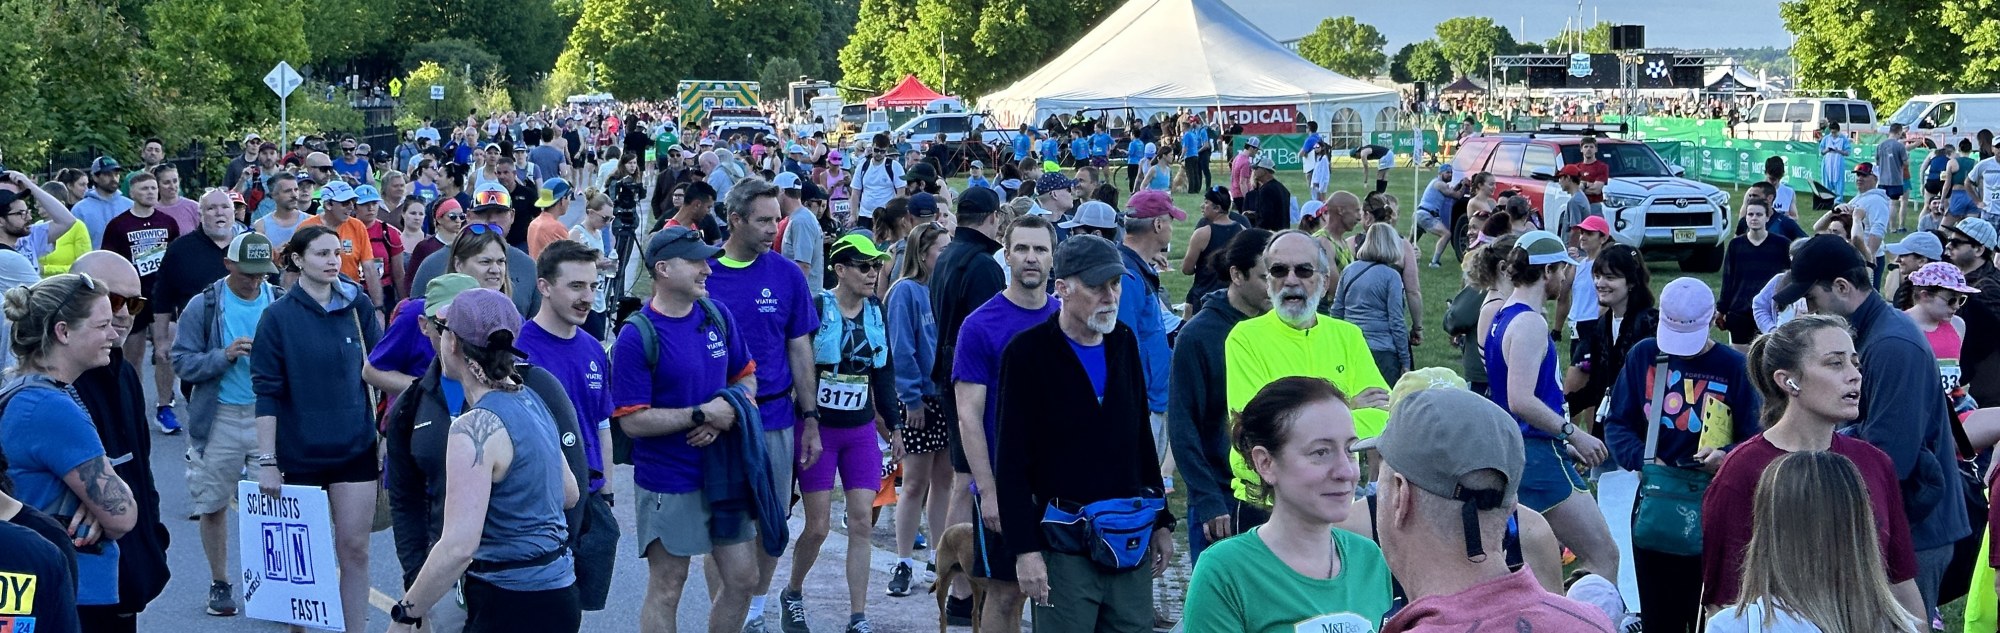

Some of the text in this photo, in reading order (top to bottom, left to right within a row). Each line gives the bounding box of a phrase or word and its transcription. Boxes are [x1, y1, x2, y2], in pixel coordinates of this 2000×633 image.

[1212, 108, 1293, 125] MEDICAL
[128, 229, 167, 241] NORWICH
[140, 258, 161, 273] 326
[820, 388, 863, 408] 3171
[247, 492, 300, 519] SCIENTISTS
[291, 598, 328, 625] FAST!
